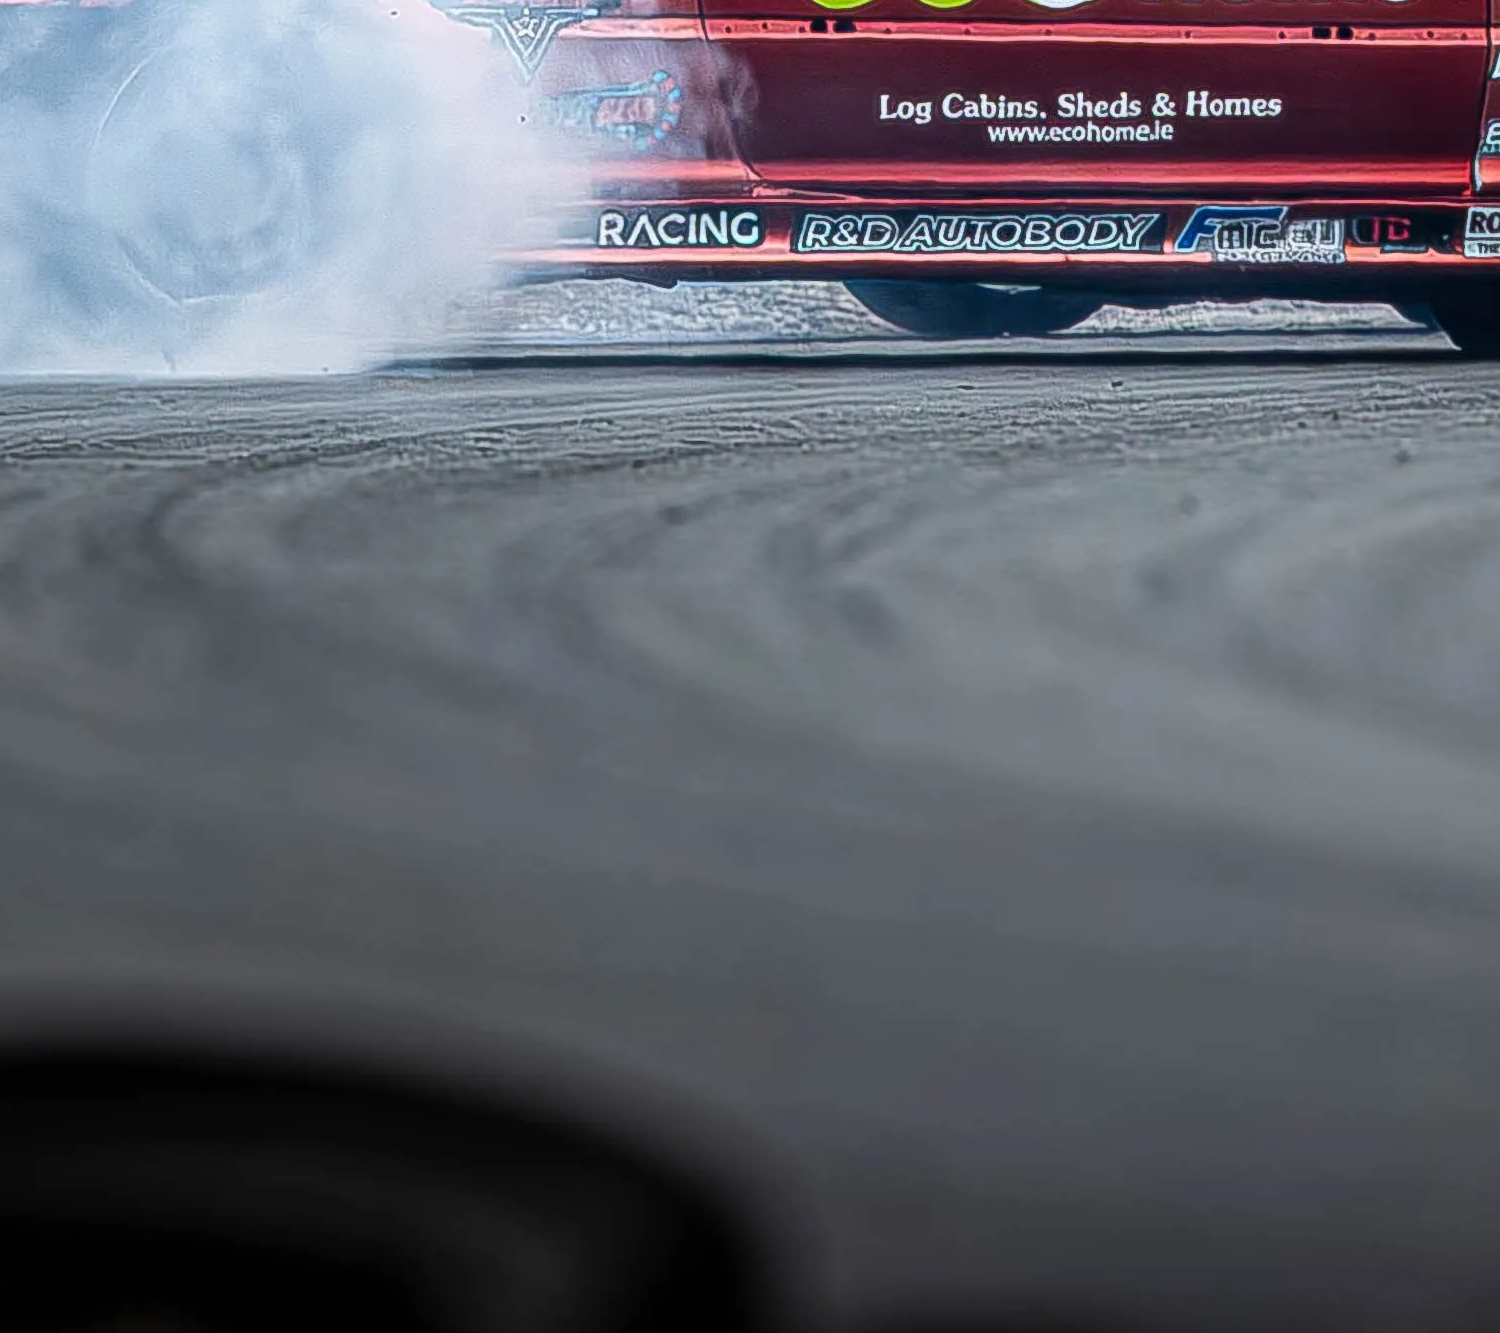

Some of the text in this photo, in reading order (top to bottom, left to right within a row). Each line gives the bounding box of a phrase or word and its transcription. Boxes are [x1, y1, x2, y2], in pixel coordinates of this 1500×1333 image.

[878, 94, 931, 124] Log
[1057, 93, 1142, 119] Sheds
[1151, 93, 1176, 118] &
[1186, 91, 1282, 118] Homes
[987, 120, 1174, 144] www.ecohome.ie
[598, 211, 760, 247] RACING
[799, 213, 1160, 251] R&D AUTOBODY
